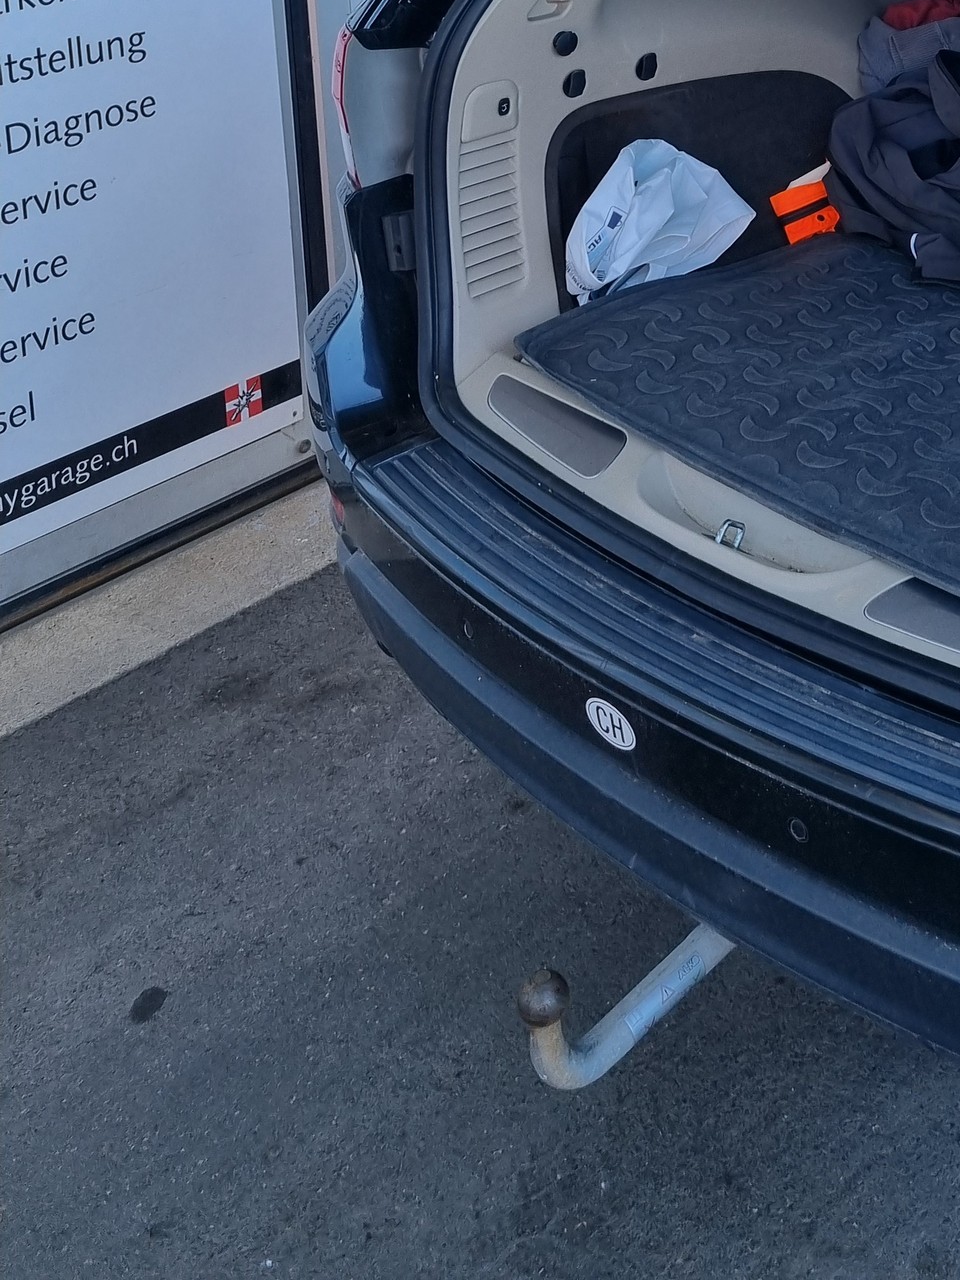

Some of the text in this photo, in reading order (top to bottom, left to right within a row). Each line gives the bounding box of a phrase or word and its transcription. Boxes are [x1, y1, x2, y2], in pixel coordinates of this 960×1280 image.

[0, 30, 147, 86] tstellung
[0, 177, 98, 225] ervice
[0, 311, 96, 363] ervice
[596, 705, 625, 744] CH
